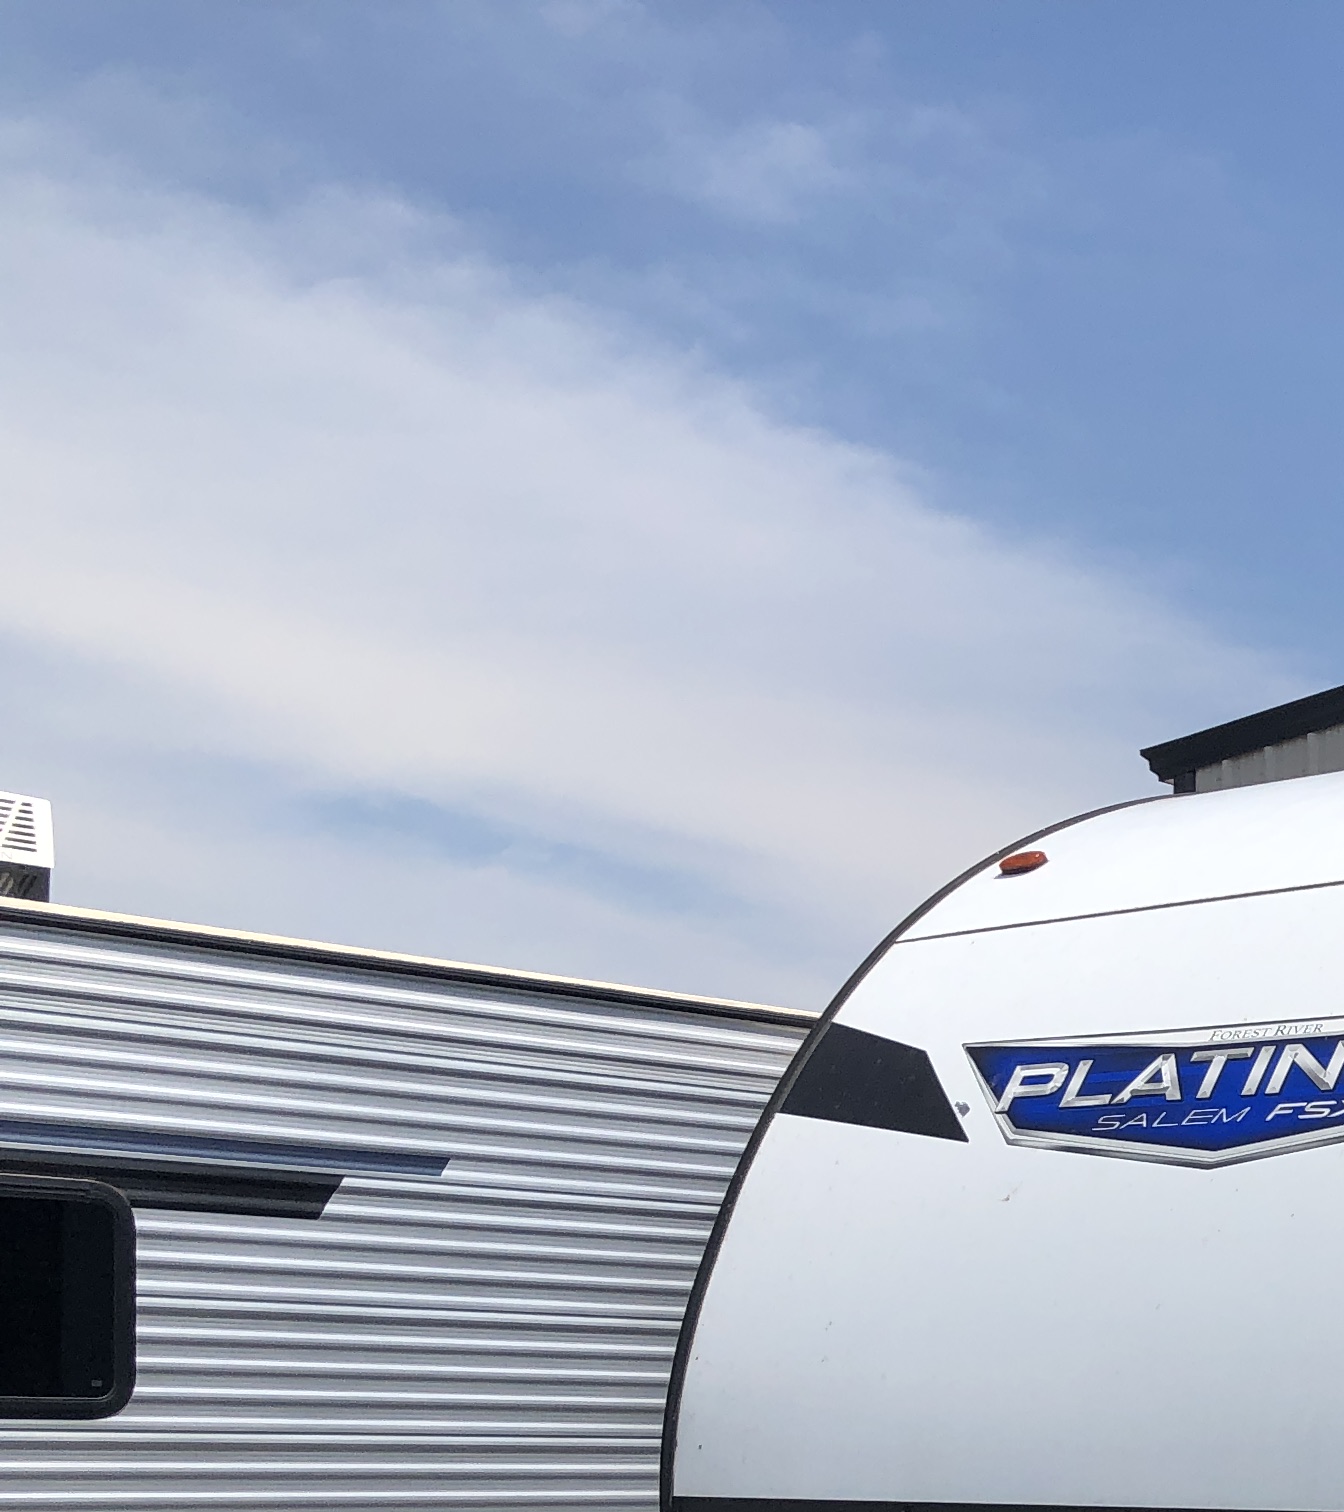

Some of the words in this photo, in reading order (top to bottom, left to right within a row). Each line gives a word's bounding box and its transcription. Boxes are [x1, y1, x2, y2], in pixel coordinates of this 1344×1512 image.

[1208, 1027, 1272, 1042] FOREST
[1274, 1023, 1324, 1036] RIVER
[1092, 1105, 1251, 1131] SALEM
